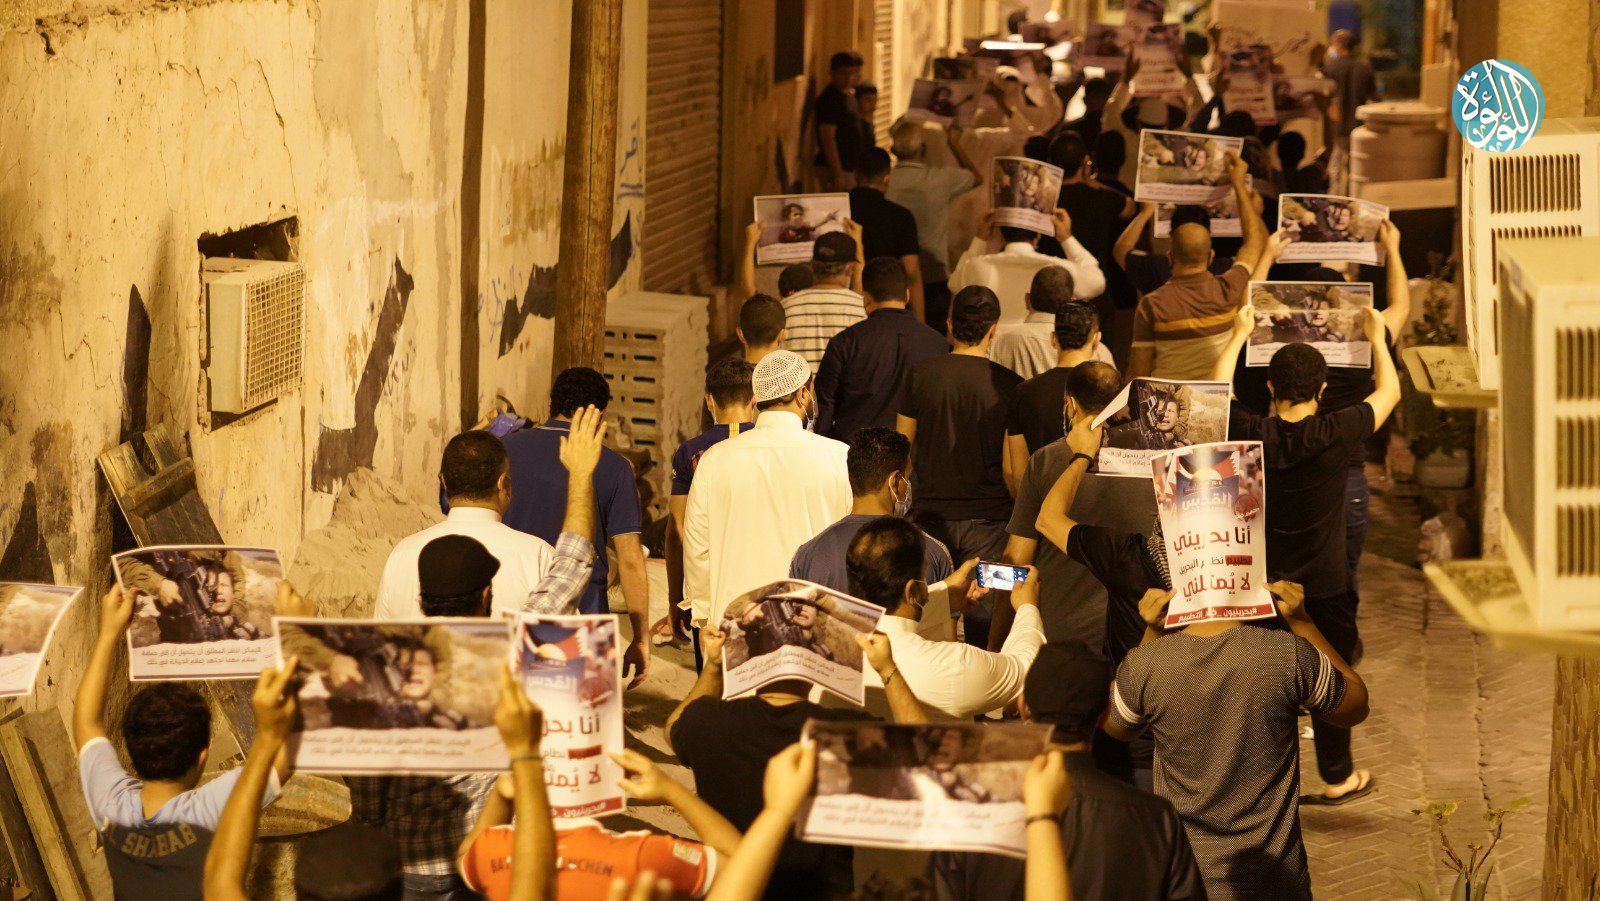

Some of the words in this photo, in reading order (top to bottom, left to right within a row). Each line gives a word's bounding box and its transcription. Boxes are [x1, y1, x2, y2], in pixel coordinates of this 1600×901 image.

[1234, 525, 1251, 545] أنا
[1240, 571, 1251, 591] لا
[579, 713, 601, 736] أنا
[583, 763, 602, 785] لا
